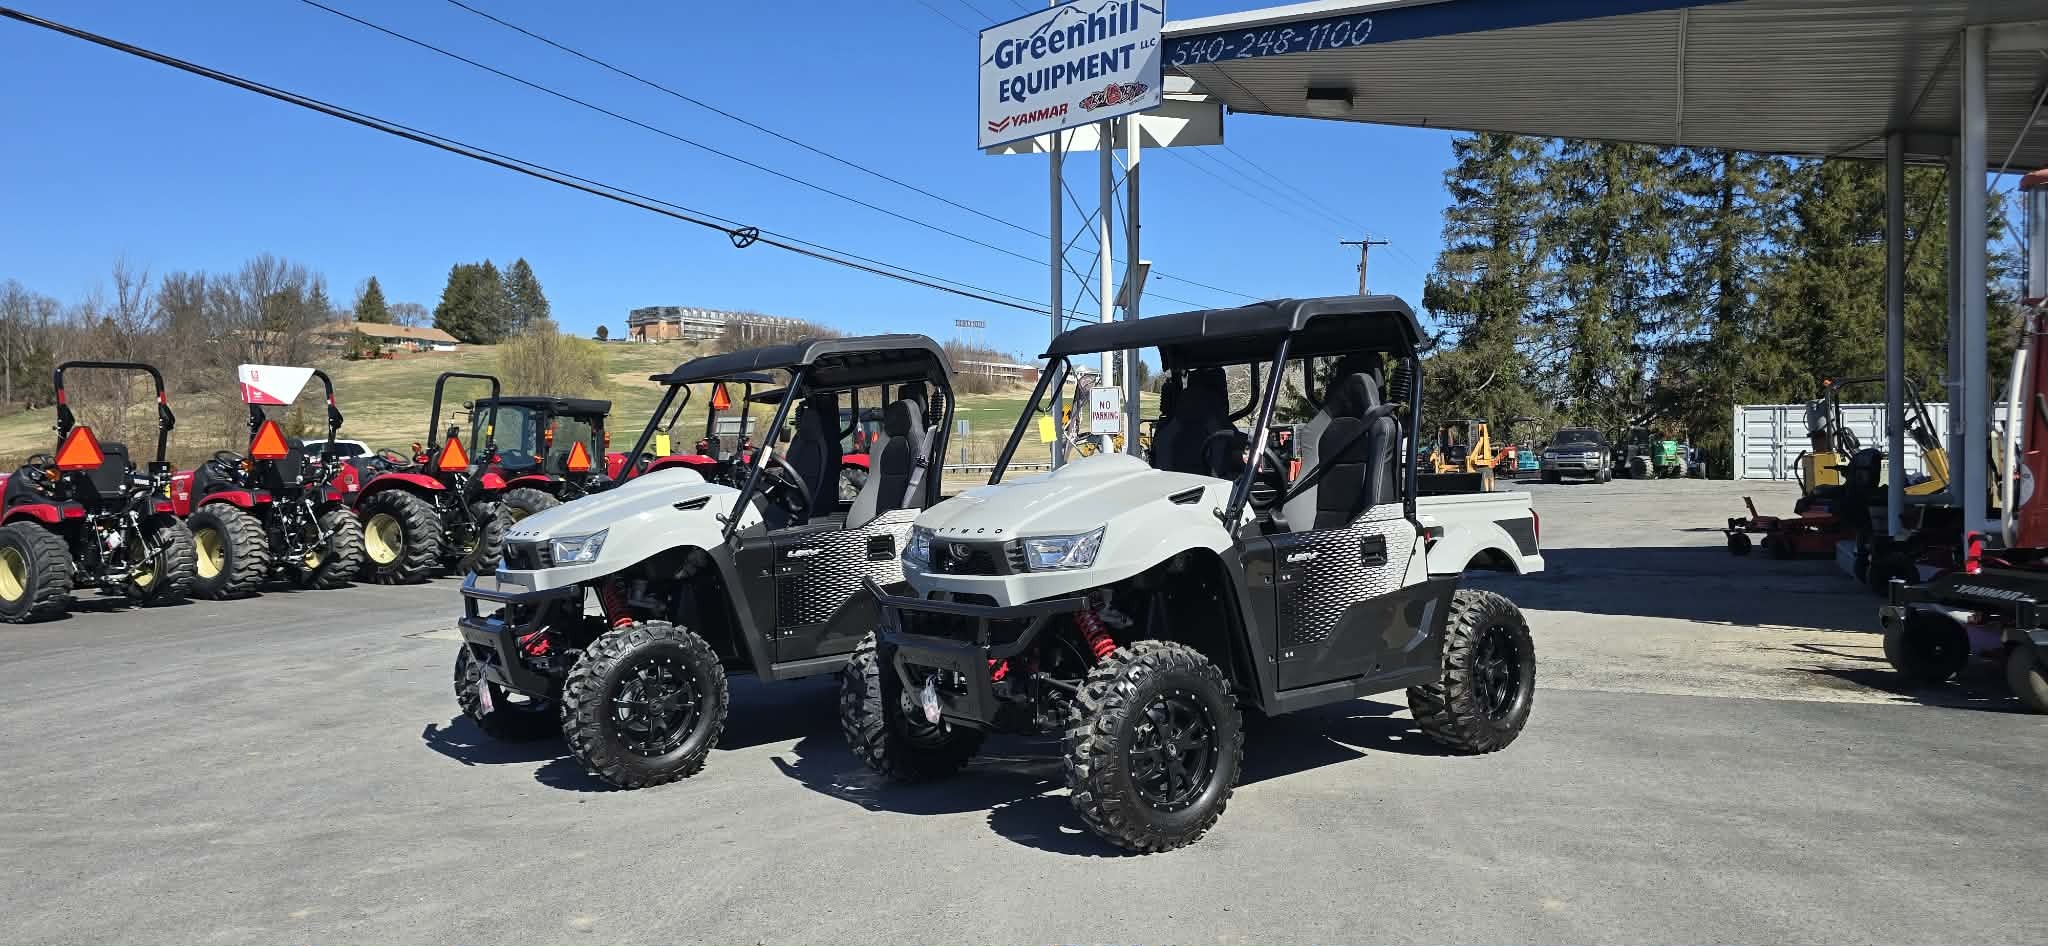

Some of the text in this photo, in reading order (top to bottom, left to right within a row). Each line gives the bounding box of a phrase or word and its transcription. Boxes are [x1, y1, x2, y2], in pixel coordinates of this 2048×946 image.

[994, 1, 1139, 69] Greenhill
[1140, 37, 1156, 50] LLC
[1171, 17, 1372, 66] 540-248-1100
[999, 43, 1136, 103] EQUIPMENT
[1011, 102, 1069, 127] YANMAR
[1092, 411, 1119, 421] PARKING
[1099, 400, 1111, 410] NO
